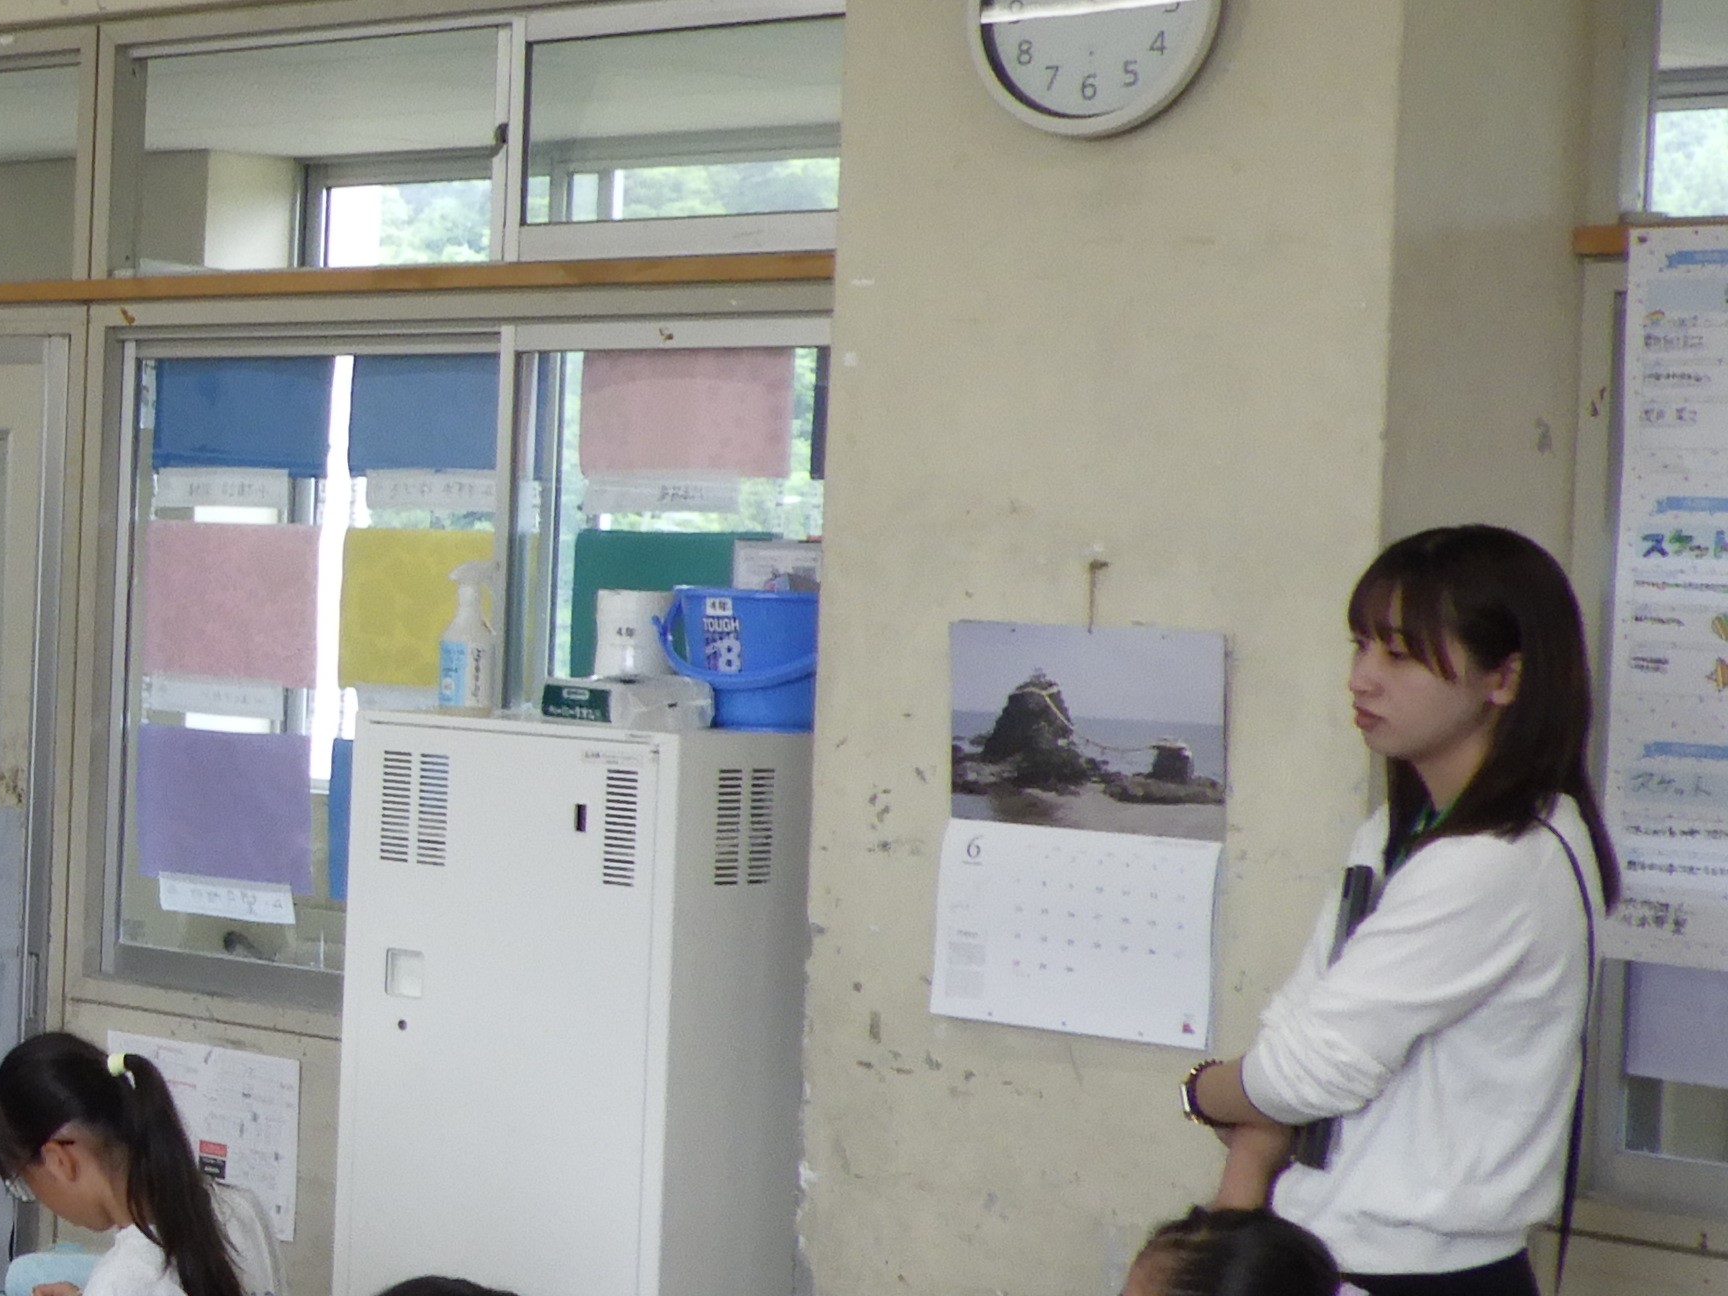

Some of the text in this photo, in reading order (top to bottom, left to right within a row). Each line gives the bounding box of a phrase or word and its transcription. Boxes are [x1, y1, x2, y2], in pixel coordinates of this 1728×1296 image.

[1016, 40, 1033, 66] 8
[1149, 30, 1167, 55] 4
[1045, 65, 1059, 91] 7
[1122, 60, 1139, 87] 5
[1081, 74, 1097, 101] 6
[702, 618, 739, 633] TOUGH
[967, 835, 984, 859] 6
